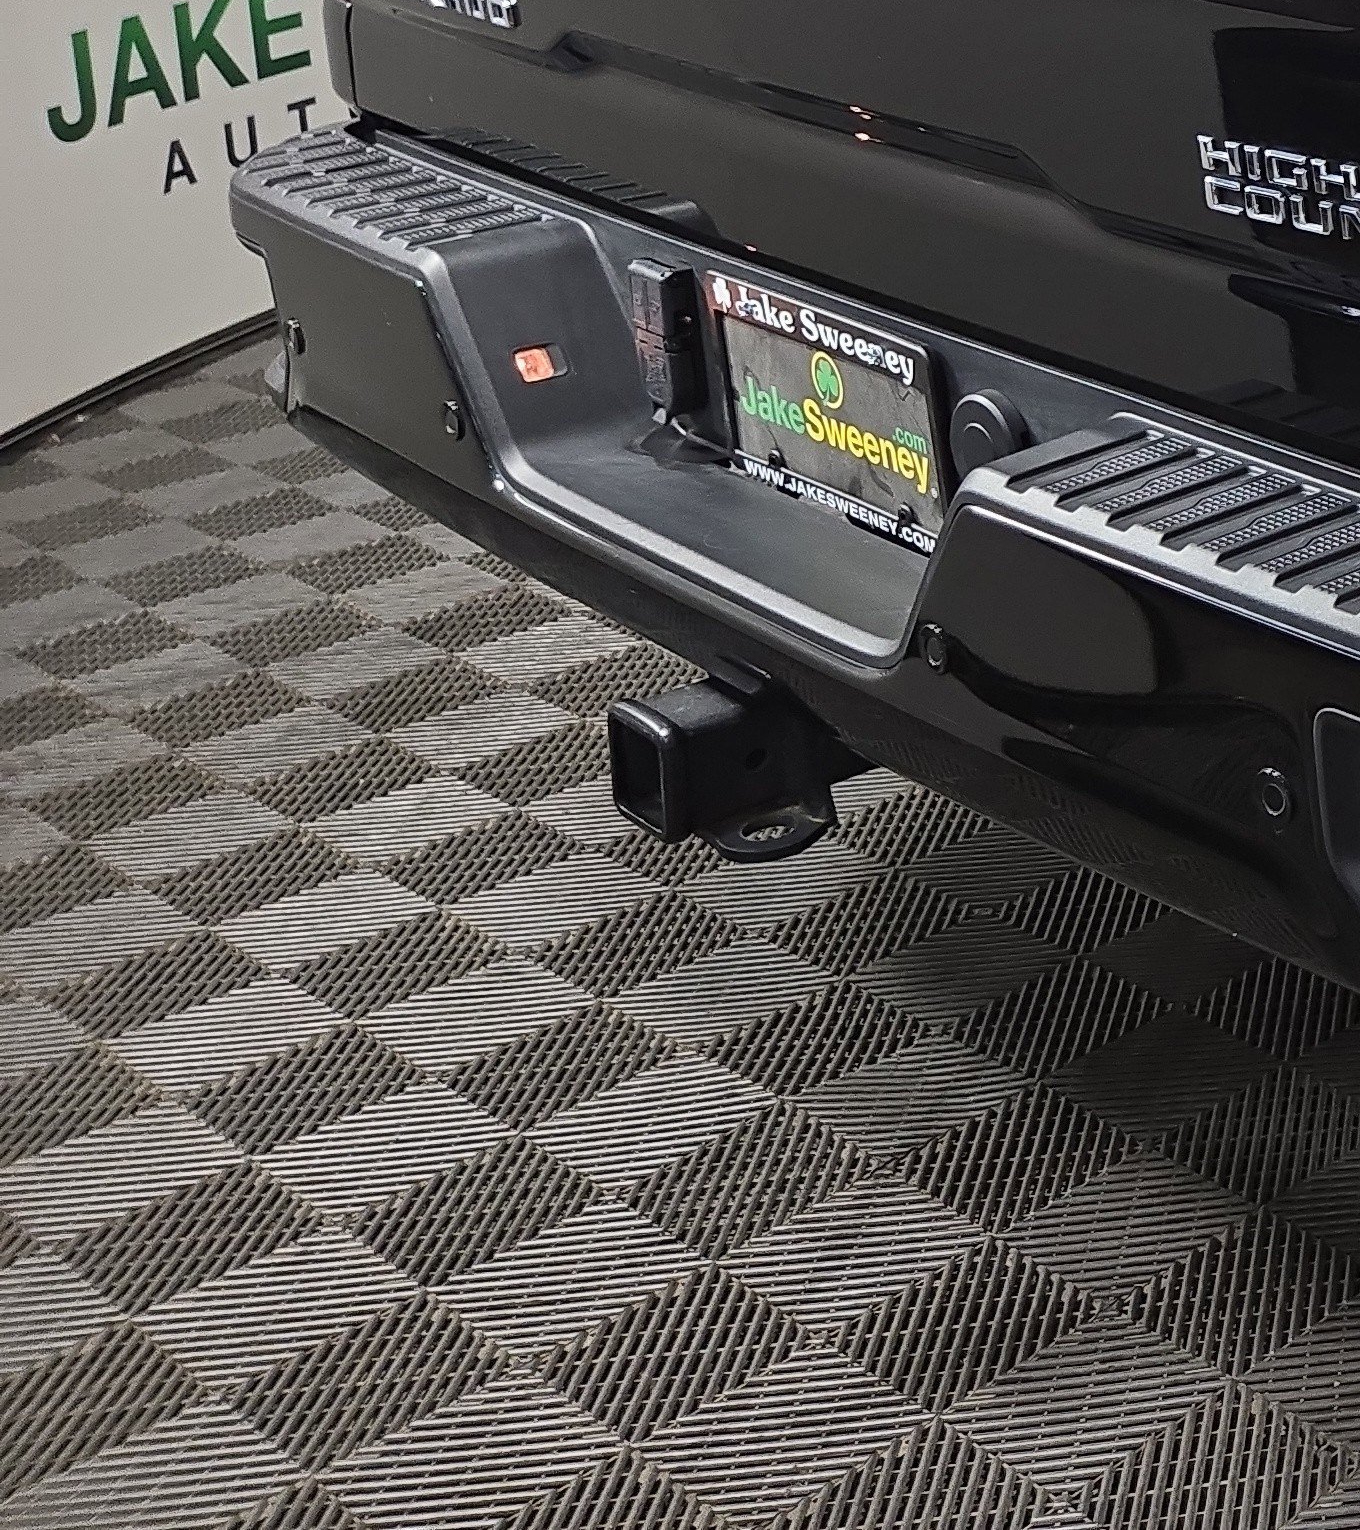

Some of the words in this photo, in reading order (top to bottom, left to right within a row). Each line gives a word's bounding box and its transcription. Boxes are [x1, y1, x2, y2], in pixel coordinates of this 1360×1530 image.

[163, 96, 319, 195] AUT
[1196, 133, 1358, 201] HIGH
[735, 286, 796, 334] Jake
[799, 309, 915, 386] Sweeney
